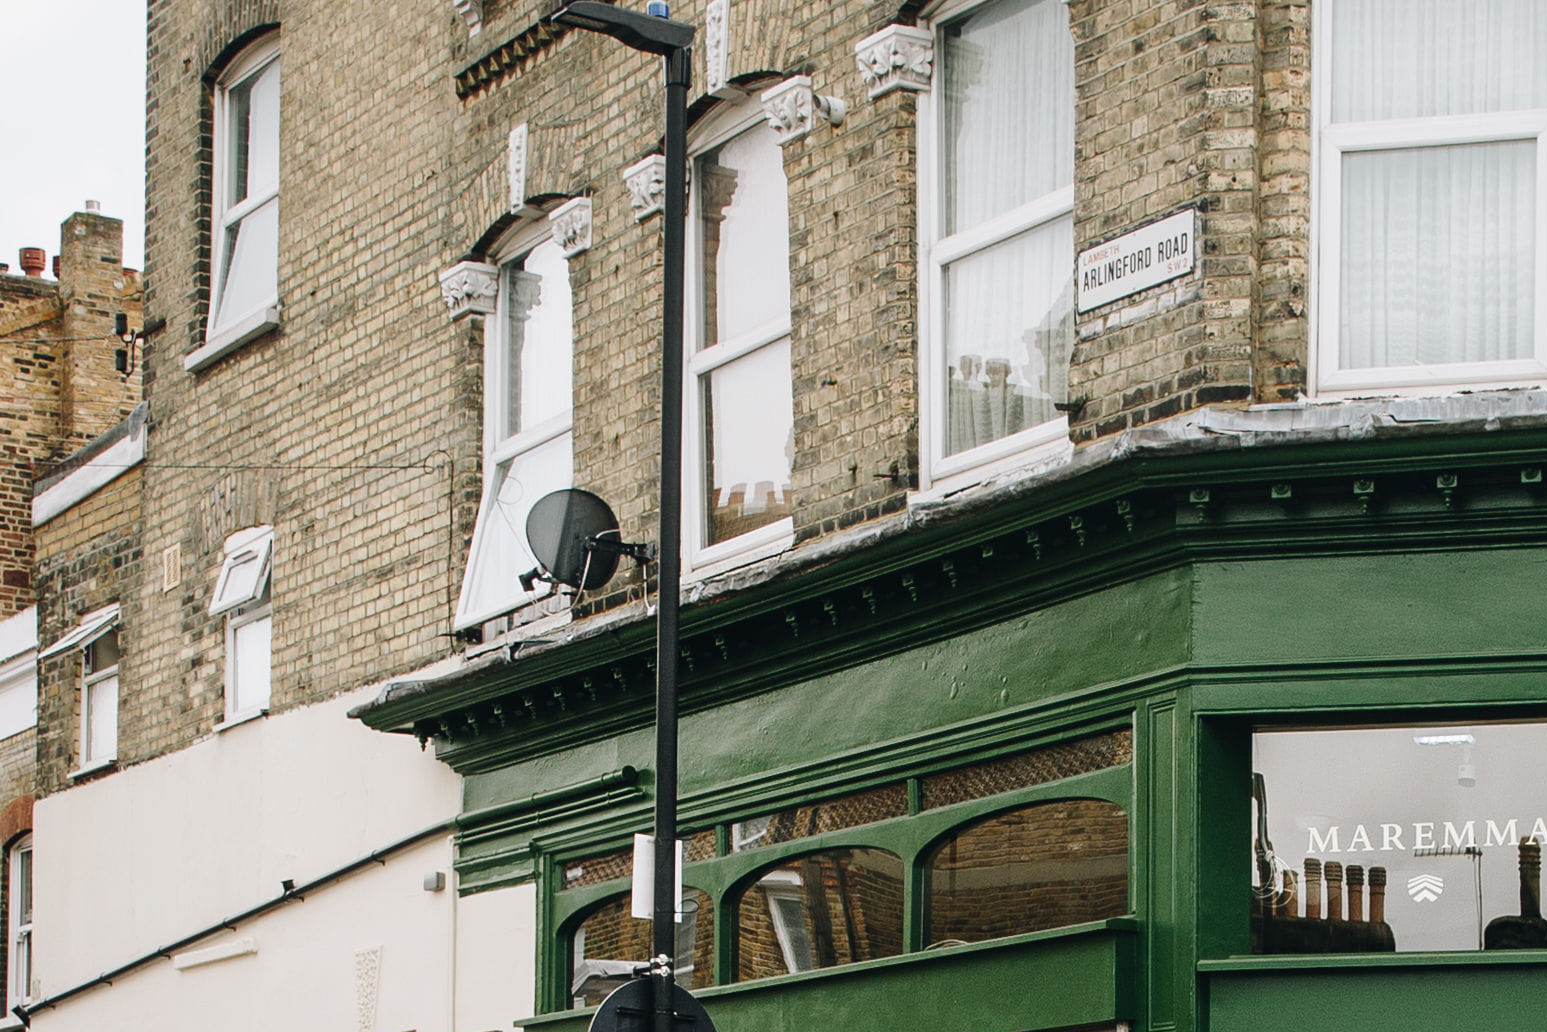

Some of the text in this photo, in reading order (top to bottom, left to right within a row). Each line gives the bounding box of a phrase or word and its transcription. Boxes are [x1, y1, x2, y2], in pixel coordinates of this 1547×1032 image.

[1083, 245, 1120, 266] LAMBETH
[1083, 232, 1188, 292] ARLINGFORD ROAD
